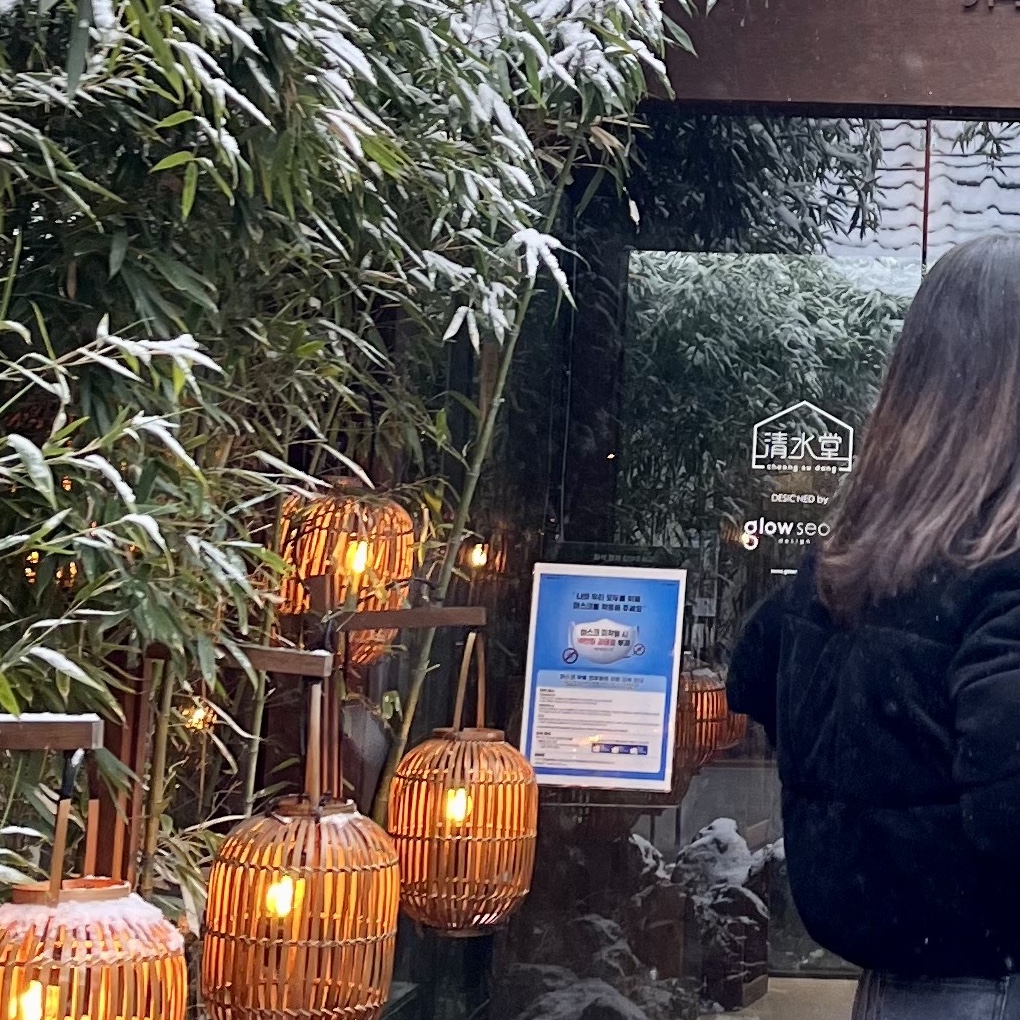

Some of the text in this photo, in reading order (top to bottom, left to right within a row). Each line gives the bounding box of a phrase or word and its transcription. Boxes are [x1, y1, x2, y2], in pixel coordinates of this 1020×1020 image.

[764, 431, 843, 460] 清水堂
[771, 493, 829, 505] DESIGNED by
[741, 516, 794, 551] glow
